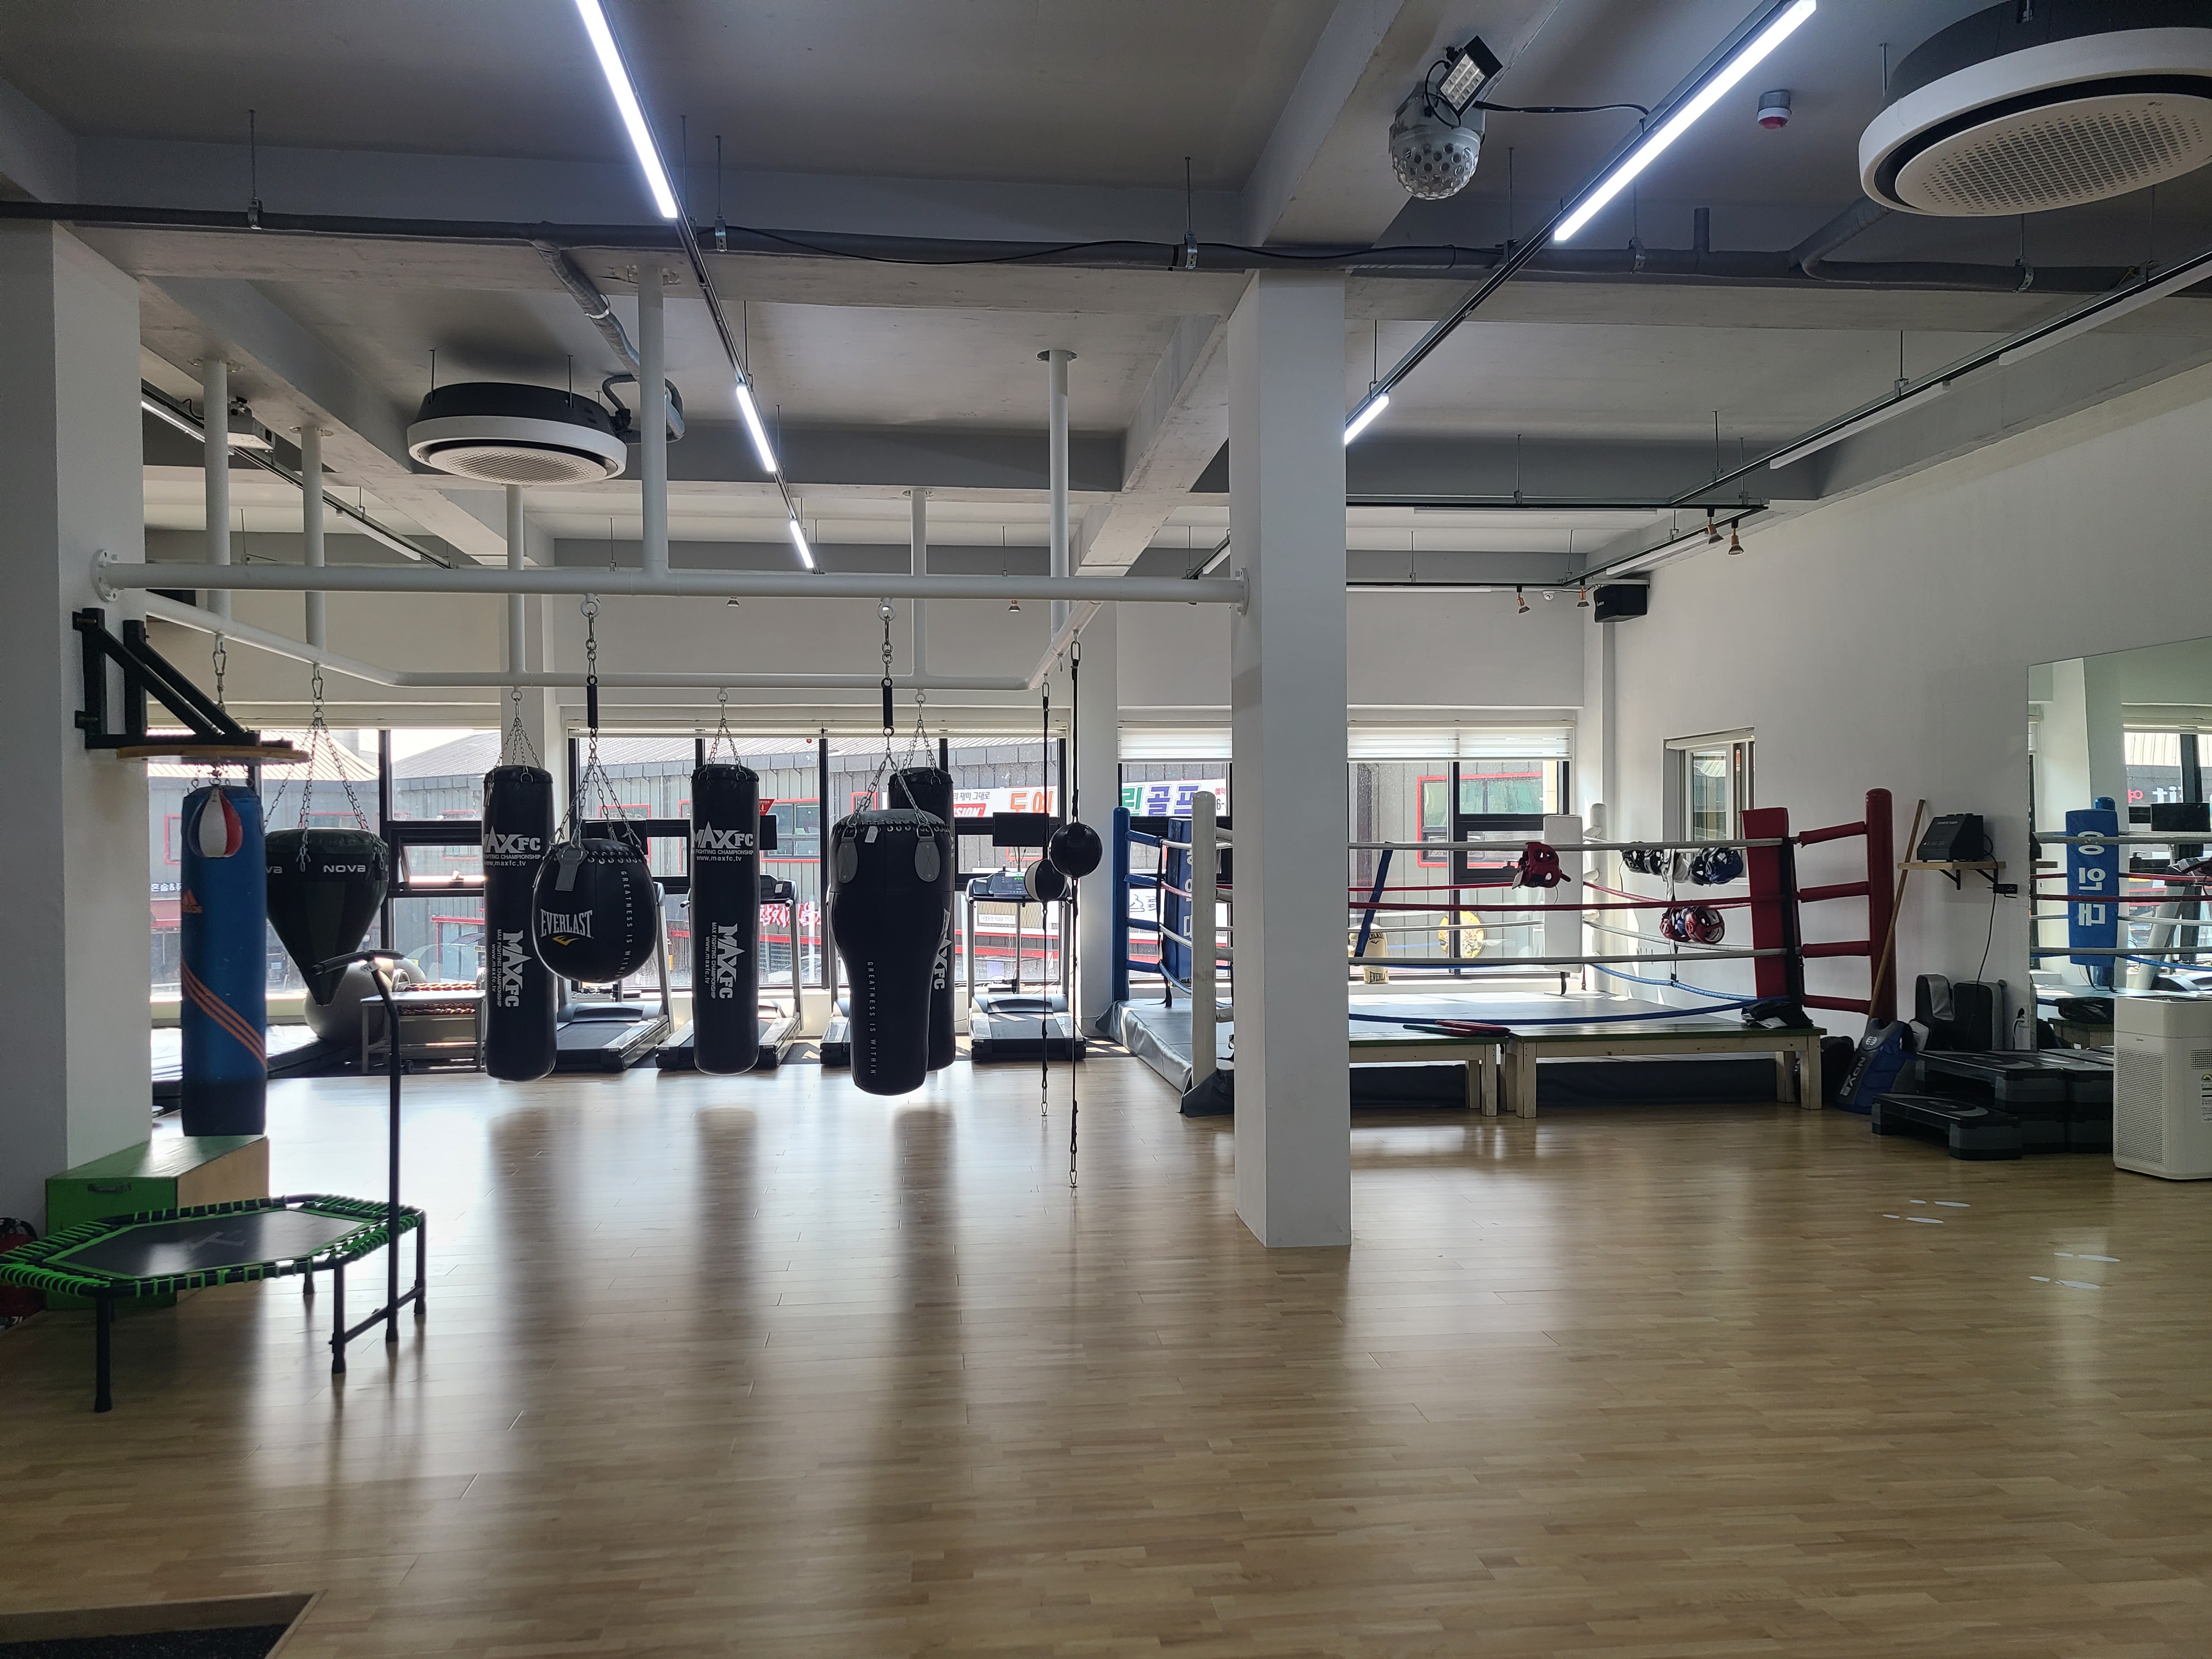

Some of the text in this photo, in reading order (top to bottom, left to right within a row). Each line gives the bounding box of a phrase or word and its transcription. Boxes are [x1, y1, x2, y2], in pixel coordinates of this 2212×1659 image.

[972, 791, 990, 800] 그대로
[620, 871, 633, 927] GREATNESS
[540, 909, 593, 938] EVERLAST
[626, 934, 633, 943] IS
[867, 961, 876, 1016] GREATNESS
[870, 1023, 876, 1032] IS
